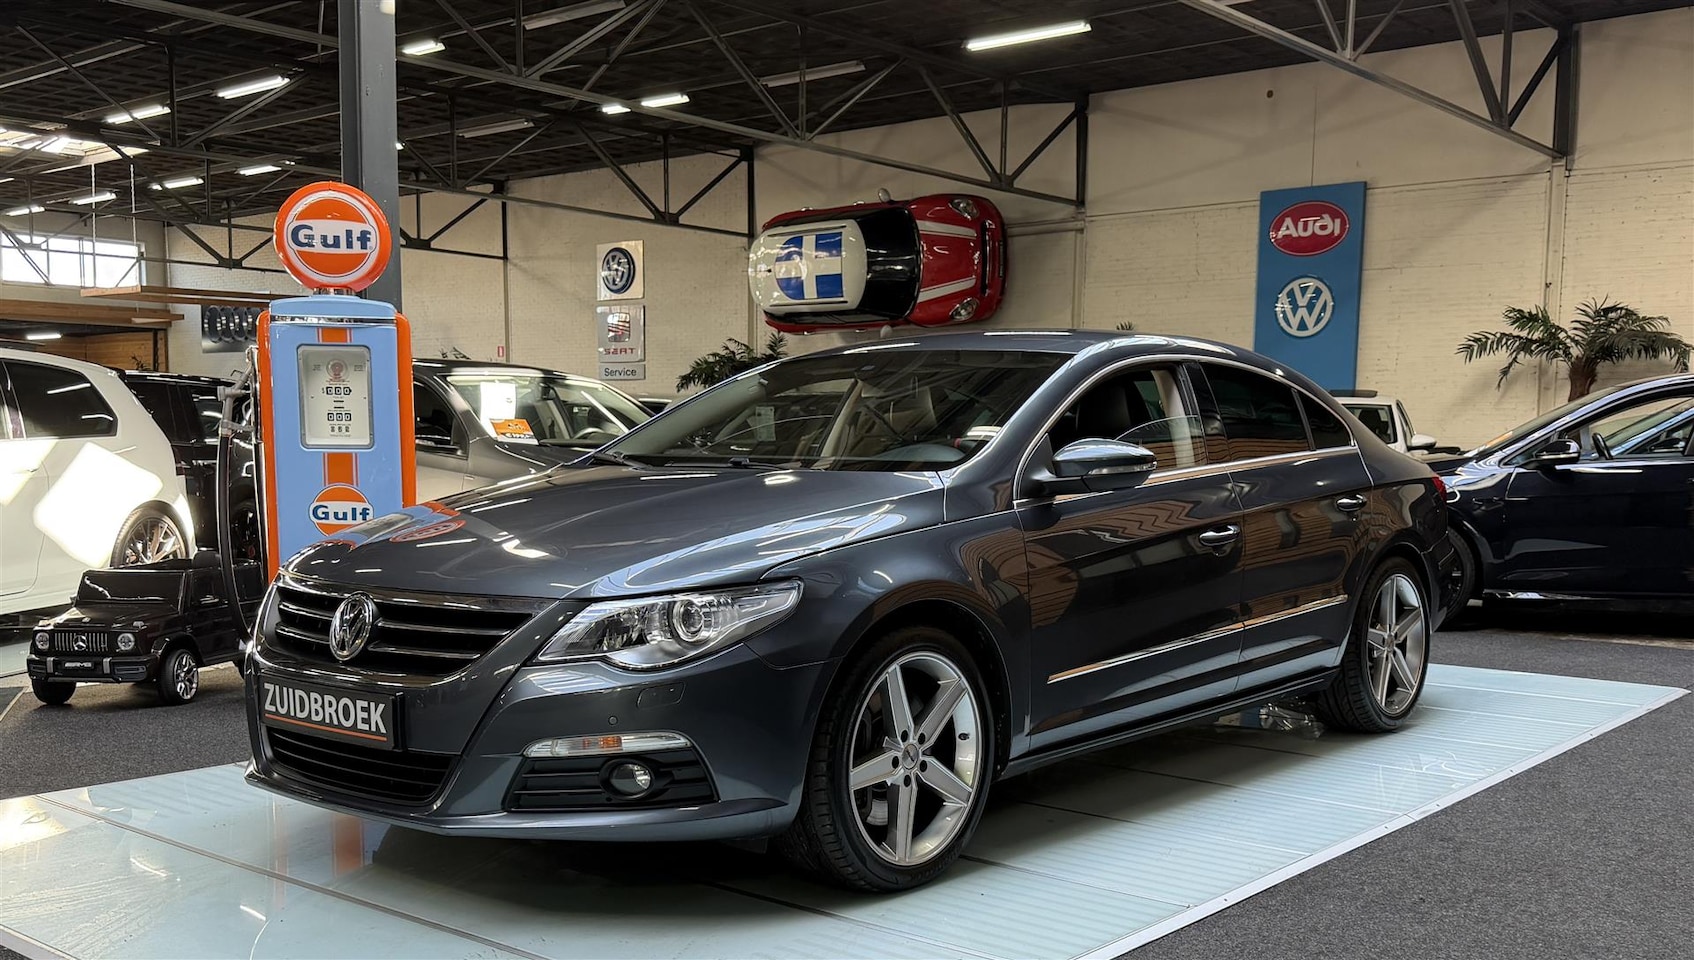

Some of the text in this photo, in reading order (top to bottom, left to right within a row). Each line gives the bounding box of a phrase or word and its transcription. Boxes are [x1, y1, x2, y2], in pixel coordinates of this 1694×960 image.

[291, 224, 371, 250] Gulf
[604, 347, 636, 356] SEAT
[604, 367, 637, 377] Service
[312, 504, 370, 521] Gulf
[264, 682, 387, 734] ZUIDBROEK
